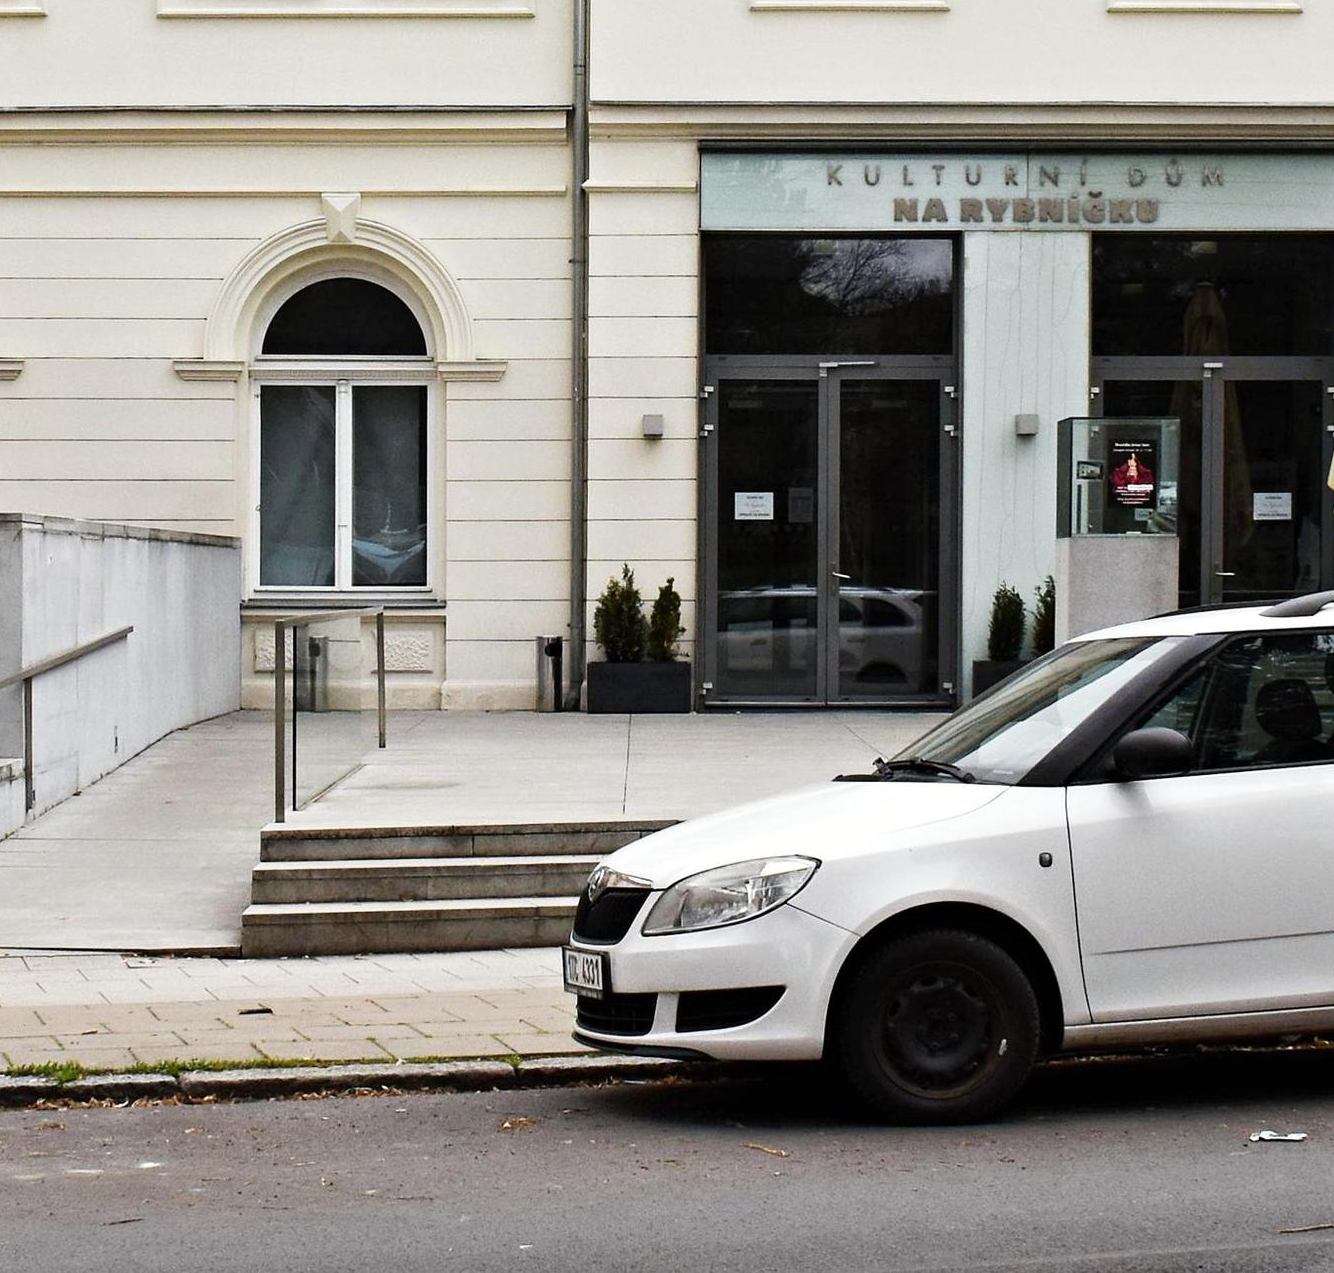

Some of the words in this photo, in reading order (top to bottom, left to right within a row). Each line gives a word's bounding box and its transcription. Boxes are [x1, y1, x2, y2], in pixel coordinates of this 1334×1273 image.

[827, 158, 1087, 187] KULTURNÍ
[1128, 157, 1224, 187] DŮM
[893, 197, 948, 223] NA
[959, 189, 1159, 224] RYBNÍČKU
[582, 955, 600, 987] 4331
